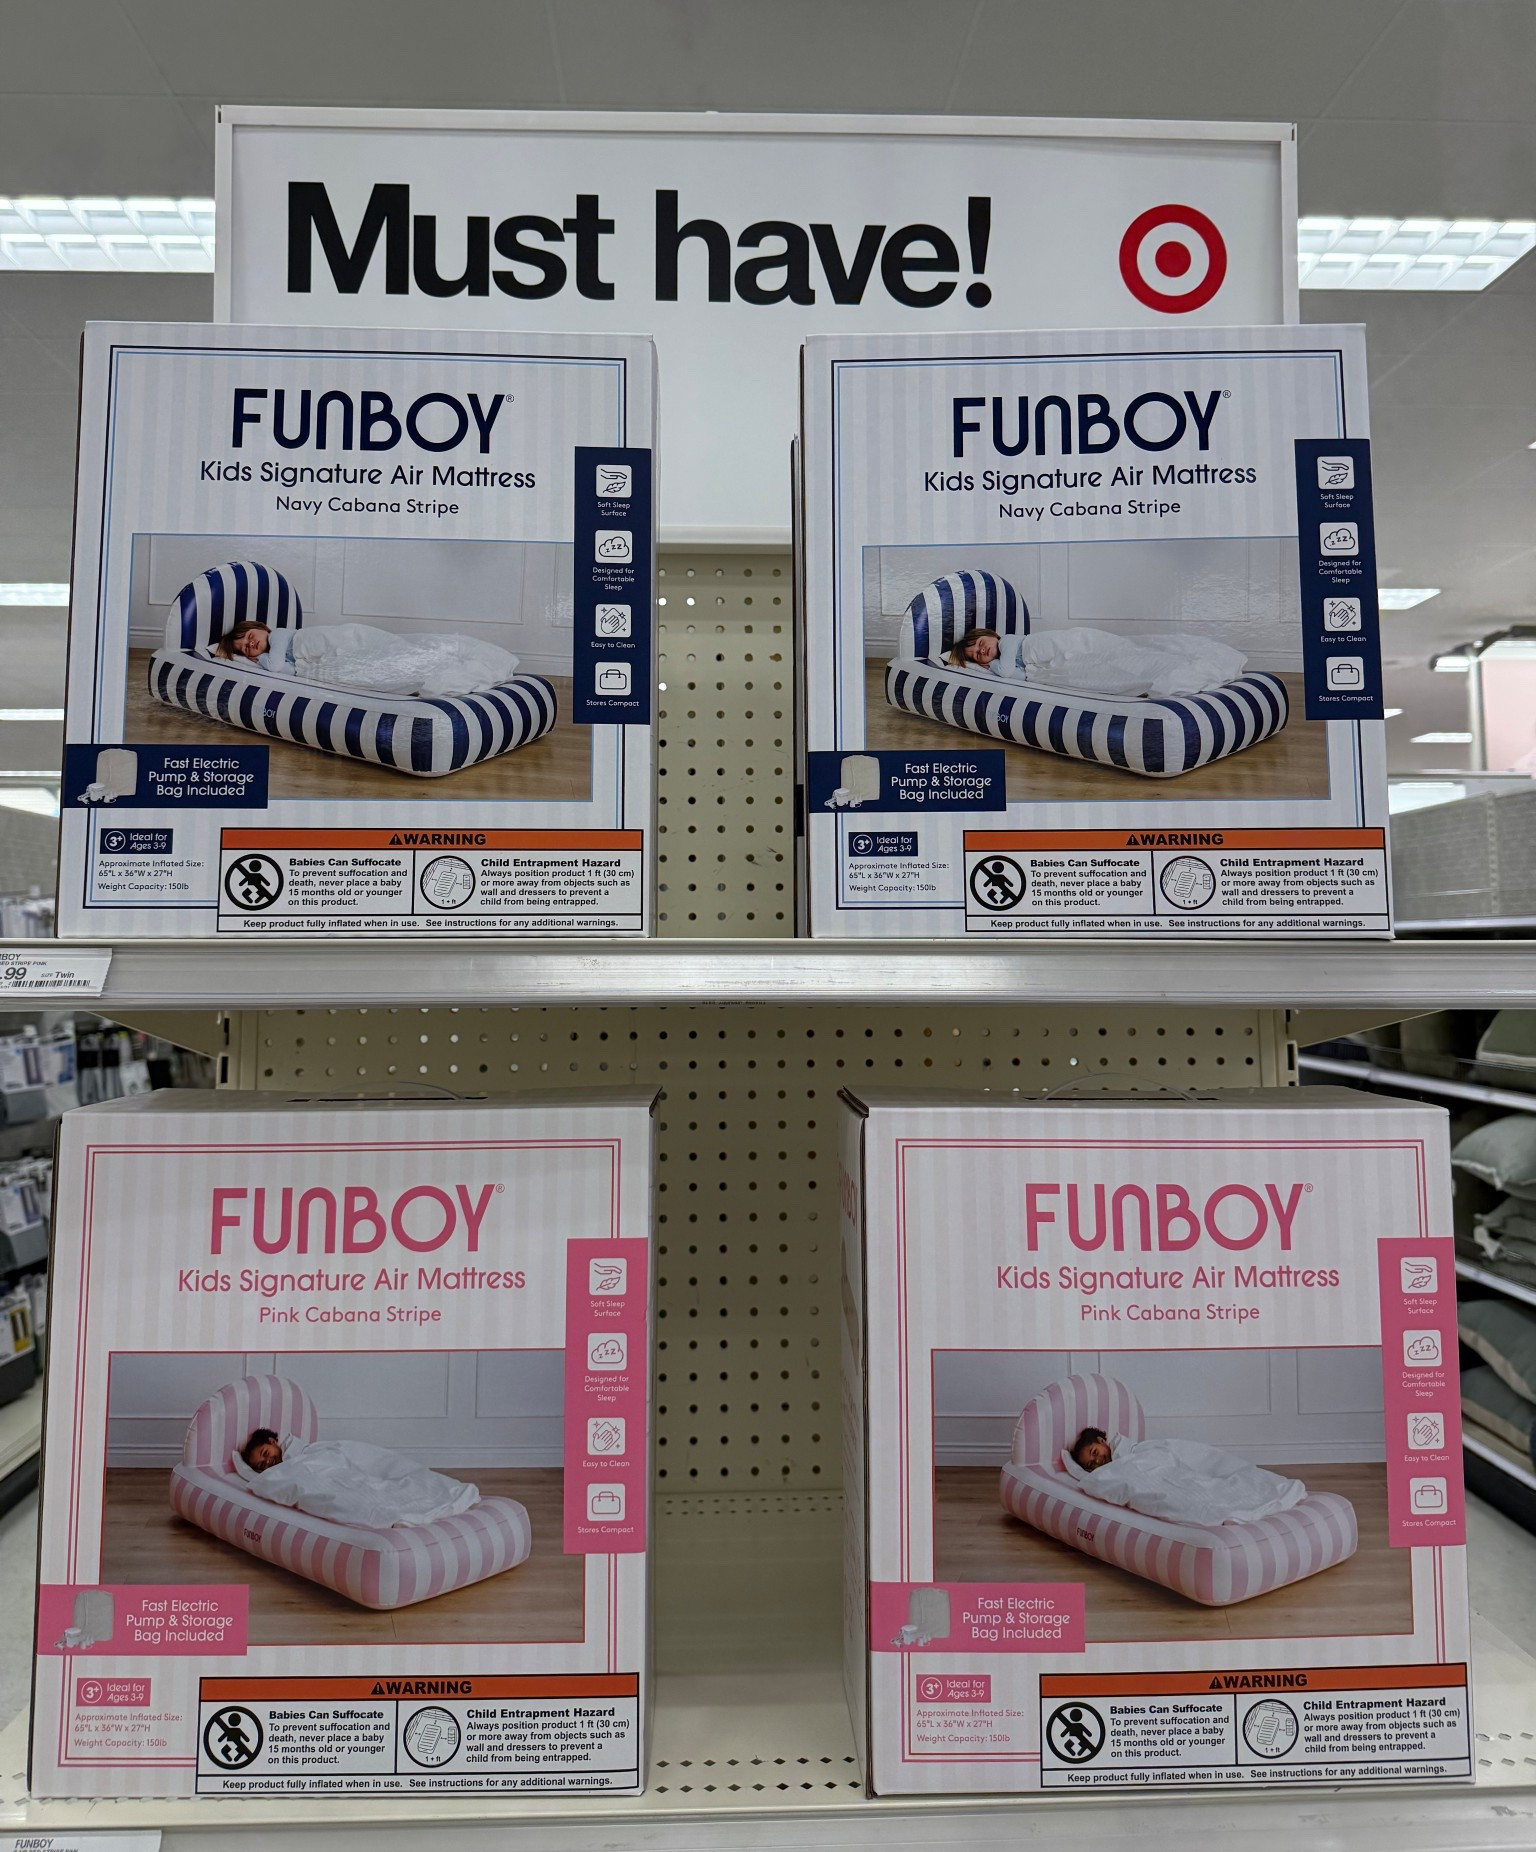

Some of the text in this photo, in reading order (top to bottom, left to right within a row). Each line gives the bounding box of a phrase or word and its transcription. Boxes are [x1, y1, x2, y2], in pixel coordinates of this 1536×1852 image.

[288, 182, 992, 308] Must have!
[201, 461, 535, 488] Kids Signature Air Mattress
[925, 464, 1256, 492] Kids Signature Air Mattress
[277, 496, 459, 518] Navy Cabana Stripe
[1000, 500, 1180, 520] Navy Cabana Stripe
[165, 758, 239, 768] Fast Electric
[906, 763, 977, 773] Fast Electric
[149, 772, 254, 784] Pump & Storage
[892, 776, 991, 788] Pump & Storage
[157, 785, 244, 796] Bag Included
[900, 789, 983, 801] Bag Included
[403, 833, 488, 846] WARNING
[1140, 833, 1226, 846] WARNING
[514, 859, 578, 868] Entrapment
[583, 859, 620, 867] Hazard
[1253, 859, 1320, 867] Entrapment
[1324, 858, 1363, 866] Hazard
[244, 920, 266, 928] Keep
[270, 920, 304, 928] product
[307, 920, 326, 928] fully
[577, 919, 618, 927] warnings.
[55, 971, 75, 979] Twin
[179, 1267, 525, 1297] Kids Signature Air Mattress
[998, 1266, 1339, 1295] Kids Signature Air Mattress
[1420, 1298, 1437, 1306] Sleep
[260, 1306, 441, 1326] Pink Cabana Stripe
[1082, 1304, 1259, 1324] Pink Cabana Stripe
[1405, 1455, 1419, 1463] Easy
[143, 1600, 218, 1611] Fast Electric
[979, 1598, 1054, 1609] Fast Electric
[127, 1615, 233, 1629] Pump & Storage
[963, 1612, 1070, 1626] Pump & Storage
[135, 1630, 223, 1643] Bag Included
[972, 1627, 1061, 1641] Bag Included
[947, 1680, 985, 1688] Ideal for
[1223, 1673, 1310, 1689] WARNING
[385, 1680, 474, 1695] WARNING
[948, 1690, 969, 1698] Ages
[1111, 1706, 1145, 1714] Babies
[1173, 1705, 1222, 1713] Suffocate
[1304, 1697, 1445, 1710] Child Entrapment Hazard
[270, 1710, 383, 1719] Babies Can Suffocate
[467, 1708, 614, 1719] Child Entrapment Hazard
[917, 1709, 969, 1718] Approximate
[269, 1723, 280, 1731] To
[283, 1724, 317, 1732] prevent
[320, 1723, 370, 1731] suffocation
[917, 1735, 946, 1744] Weight
[948, 1735, 987, 1743] Capacity:
[14, 1838, 54, 1849] FUNBOY
